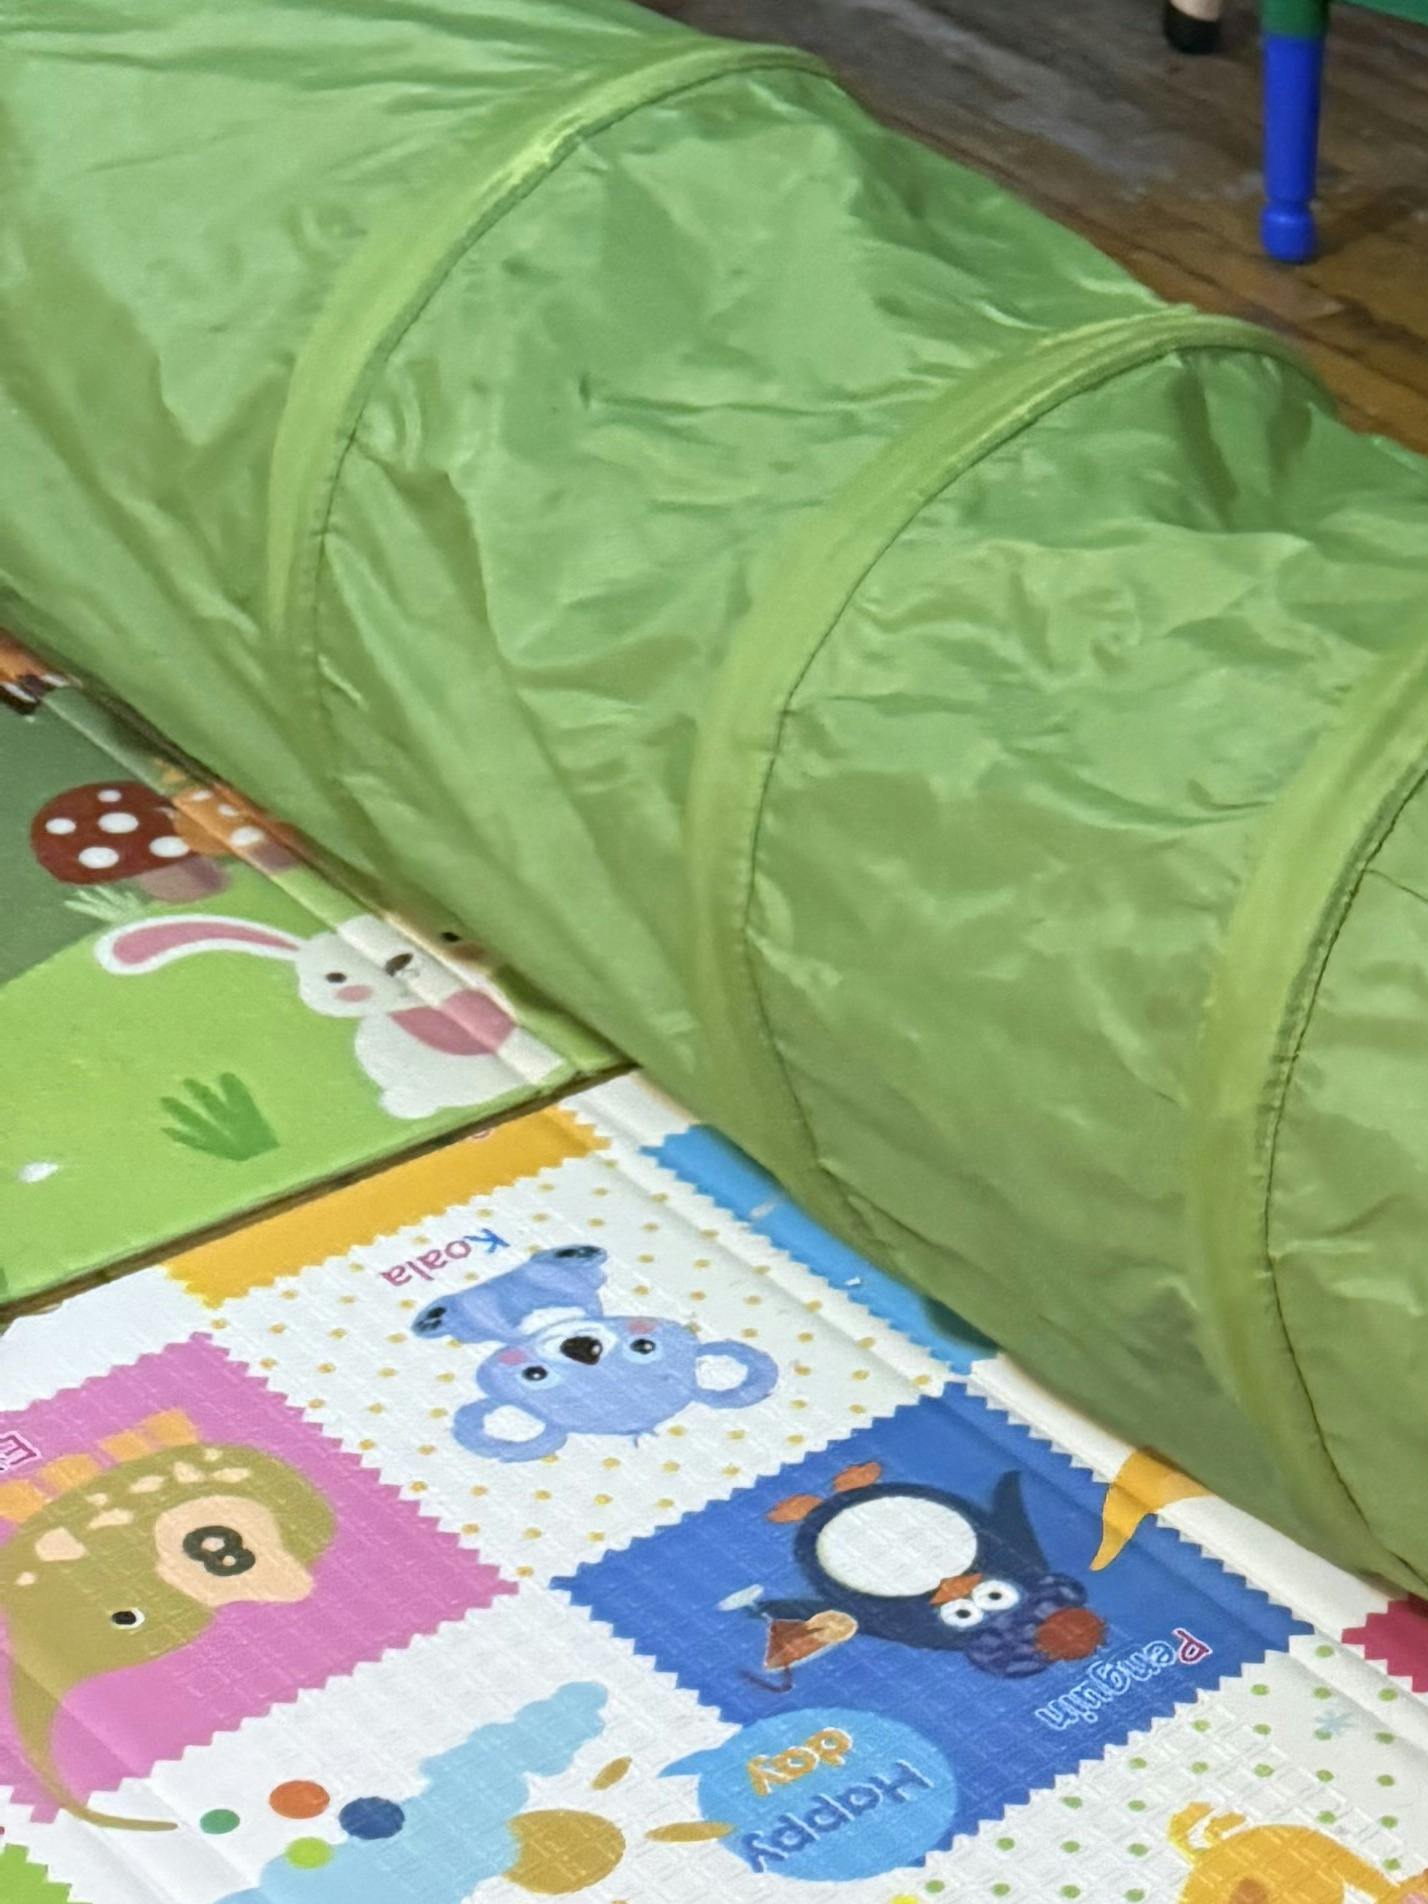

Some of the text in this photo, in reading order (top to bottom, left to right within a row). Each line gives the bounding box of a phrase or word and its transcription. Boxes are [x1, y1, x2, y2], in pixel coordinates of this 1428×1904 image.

[380, 1228, 511, 1286] Koala
[1035, 1628, 1213, 1730] Penguin
[746, 1727, 853, 1795] day
[742, 1759, 934, 1872] Happy
